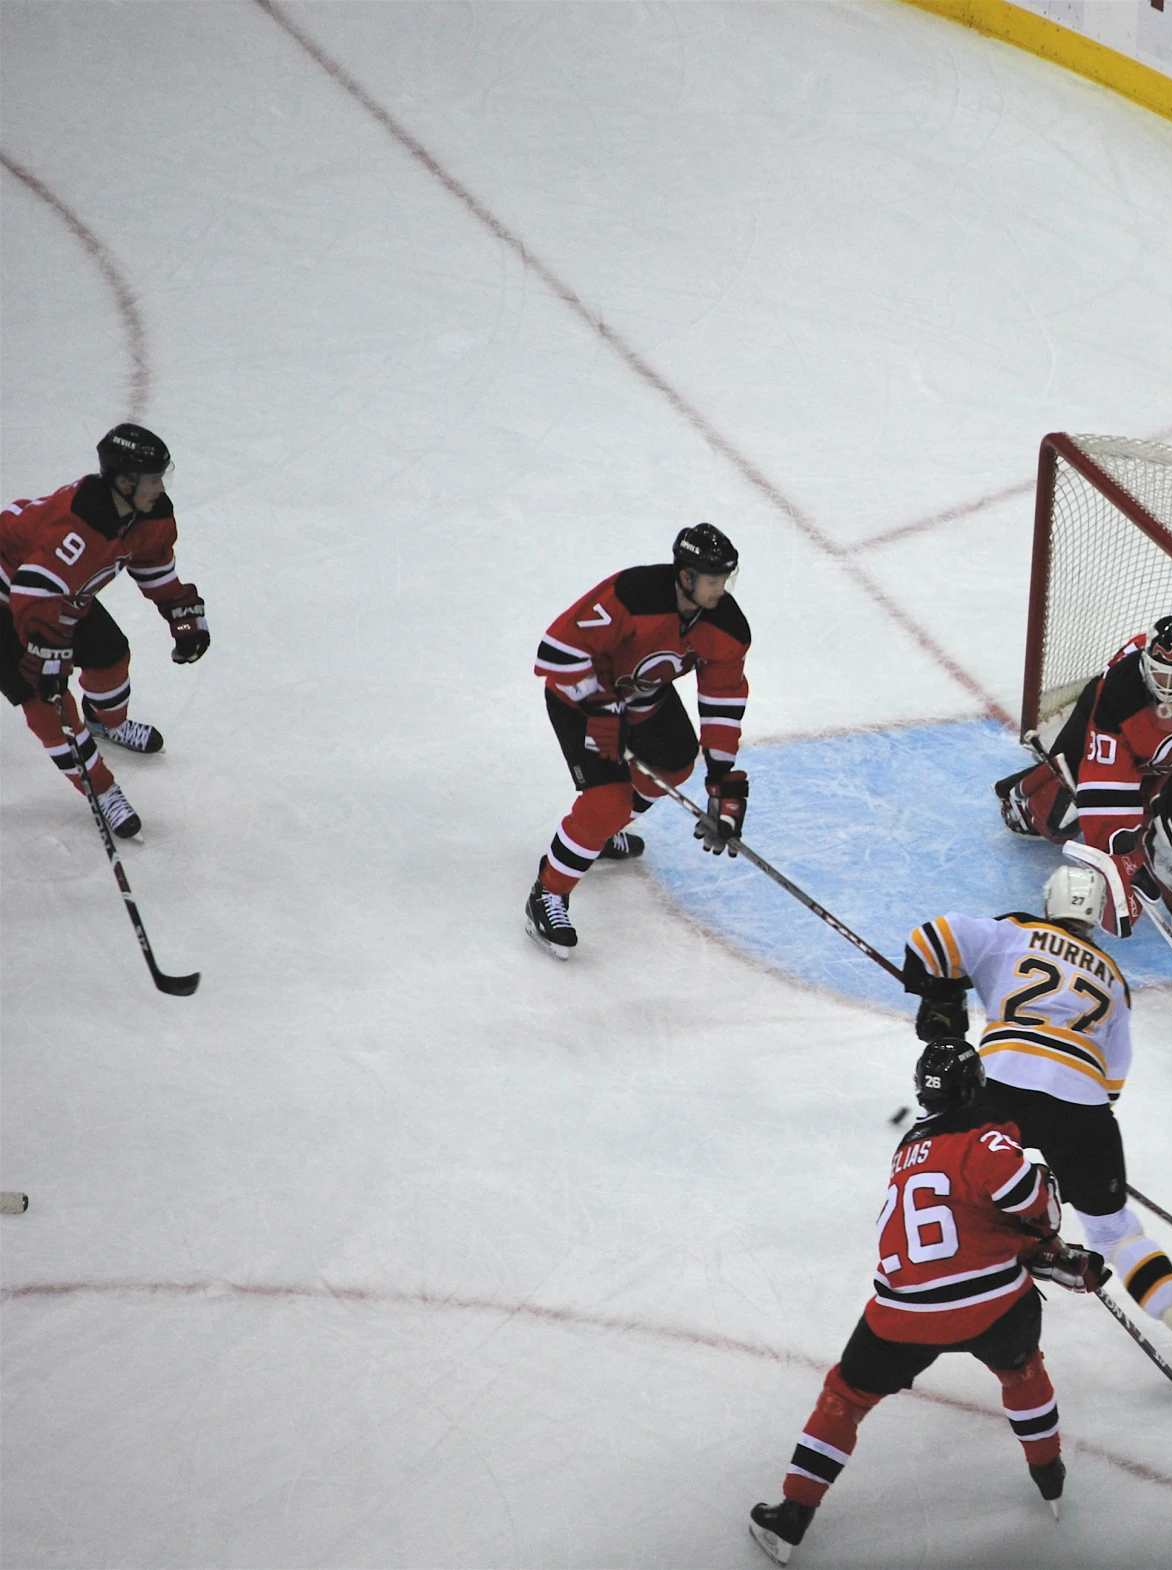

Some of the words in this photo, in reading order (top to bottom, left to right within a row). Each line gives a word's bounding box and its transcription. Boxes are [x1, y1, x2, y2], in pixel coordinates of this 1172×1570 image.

[55, 532, 86, 566] 9
[576, 603, 612, 628] 7
[1071, 896, 1084, 906] 27
[1029, 931, 1115, 988] MURRAY
[1001, 954, 1115, 1034] 27
[925, 1075, 942, 1089] 26
[877, 1172, 960, 1274] 26
